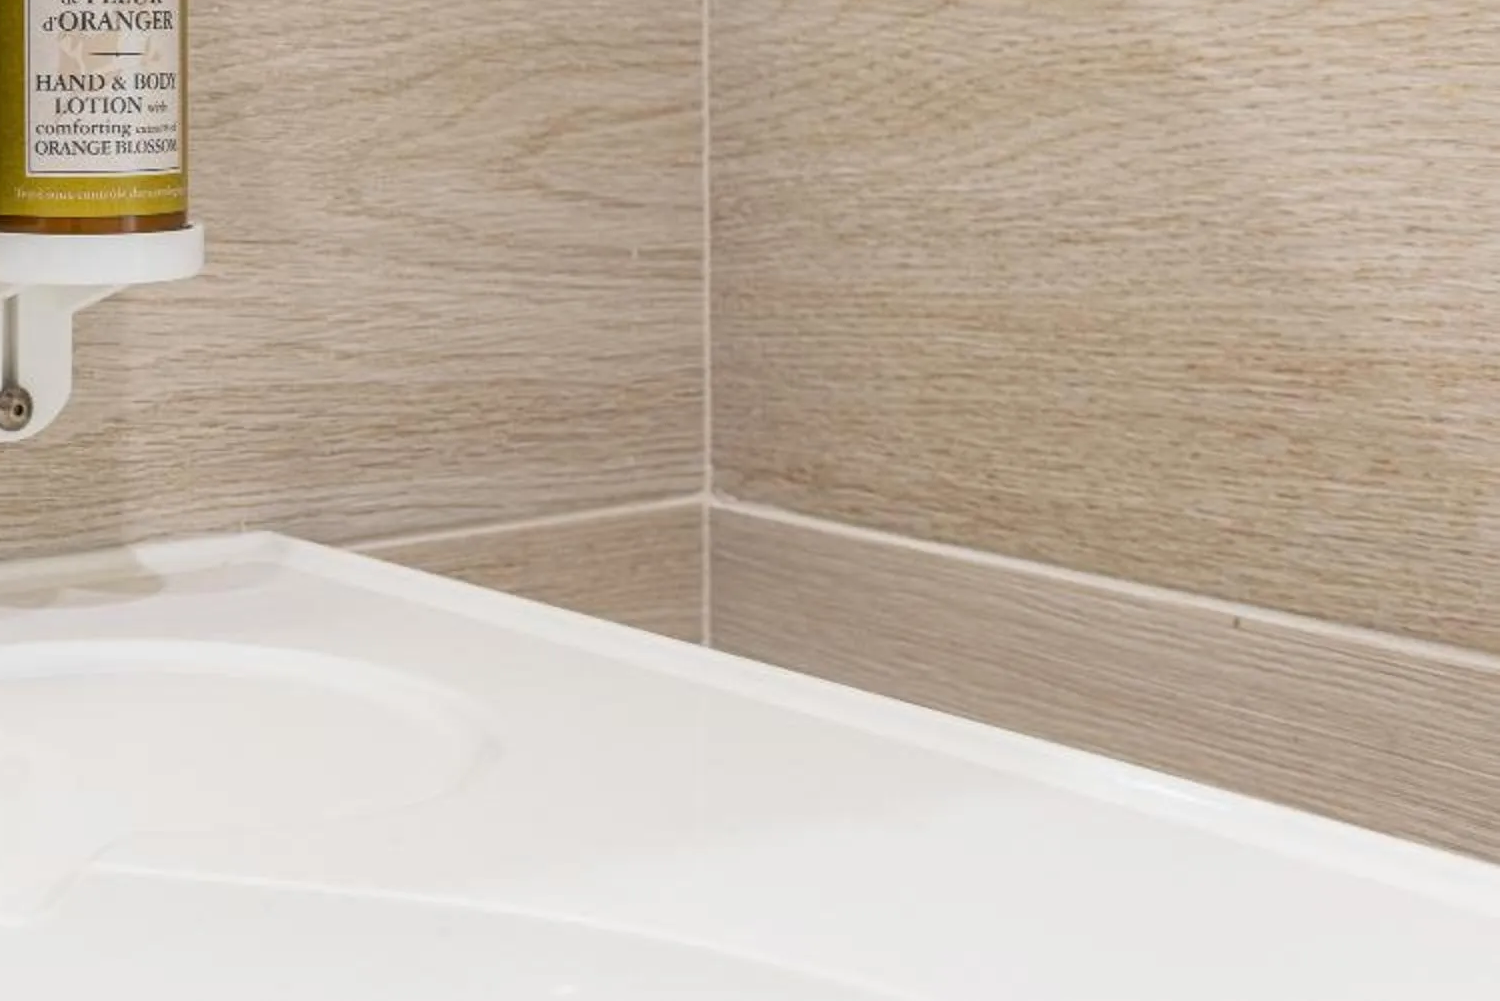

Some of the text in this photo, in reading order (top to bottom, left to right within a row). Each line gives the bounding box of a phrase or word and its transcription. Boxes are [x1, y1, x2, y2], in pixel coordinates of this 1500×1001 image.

[42, 10, 174, 32] d'ORANGER
[35, 72, 176, 92] HAND & BODY
[54, 96, 143, 115] LOTION
[35, 118, 132, 137] comforting
[35, 138, 177, 156] ORANGE BLOSSOM
